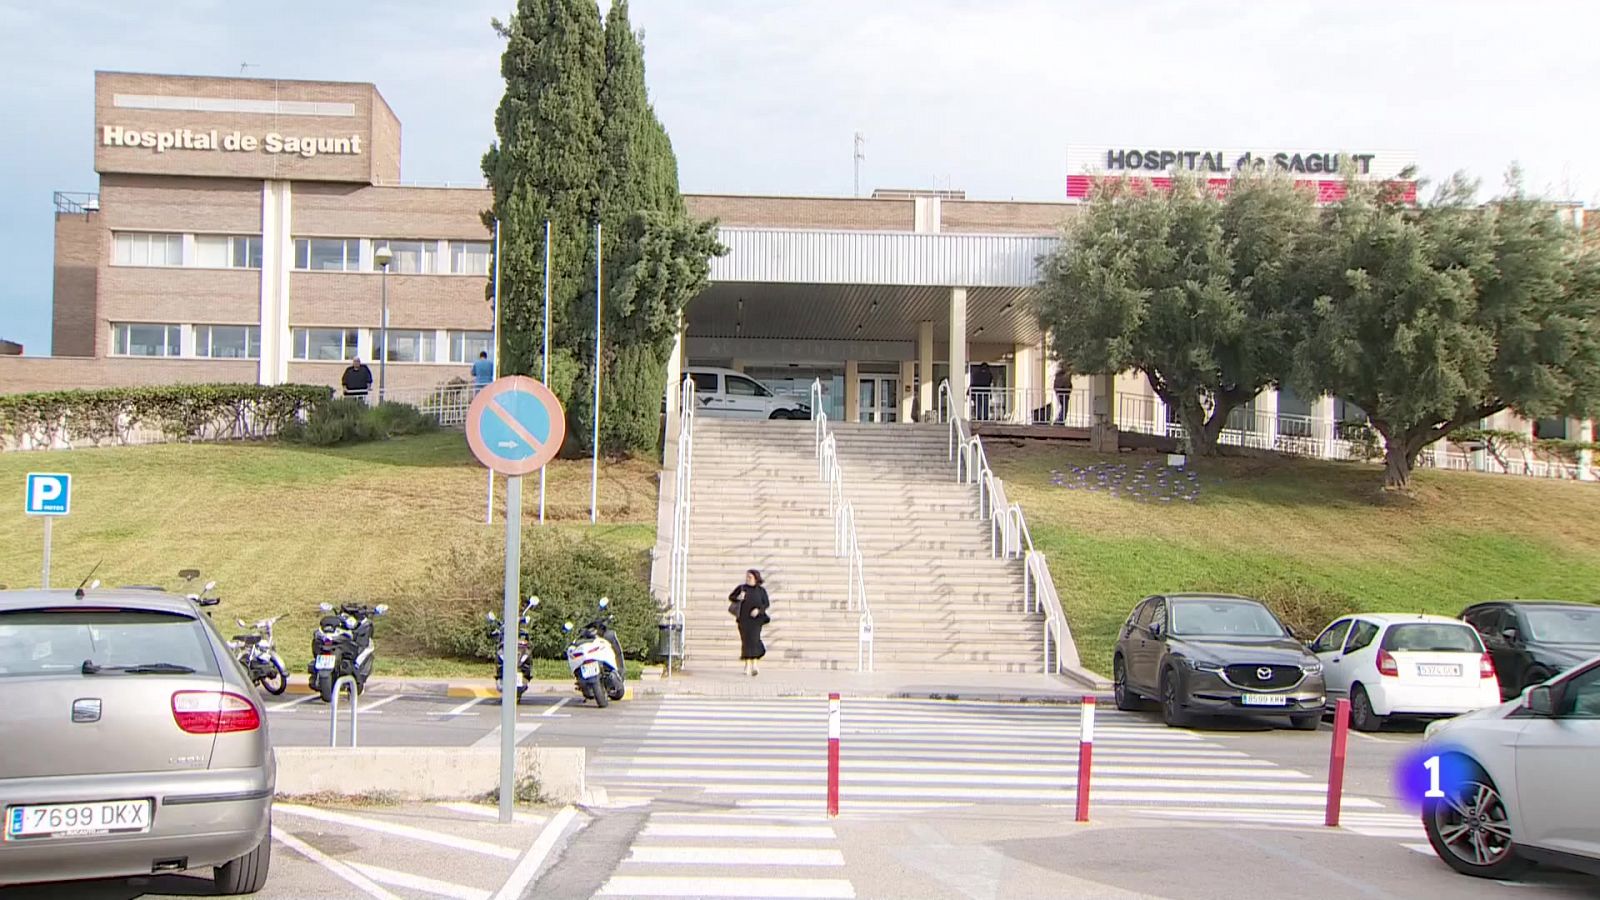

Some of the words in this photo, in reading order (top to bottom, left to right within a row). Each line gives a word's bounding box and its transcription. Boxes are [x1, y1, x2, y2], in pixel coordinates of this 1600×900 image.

[103, 125, 218, 152] Hospital
[224, 131, 257, 151] de
[265, 132, 361, 156] Sagunt
[1107, 149, 1230, 172] HOSPITAL
[1273, 152, 1376, 174] SAGUT
[32, 476, 62, 511] P
[34, 807, 93, 827] 7699
[101, 804, 142, 825] DKX
